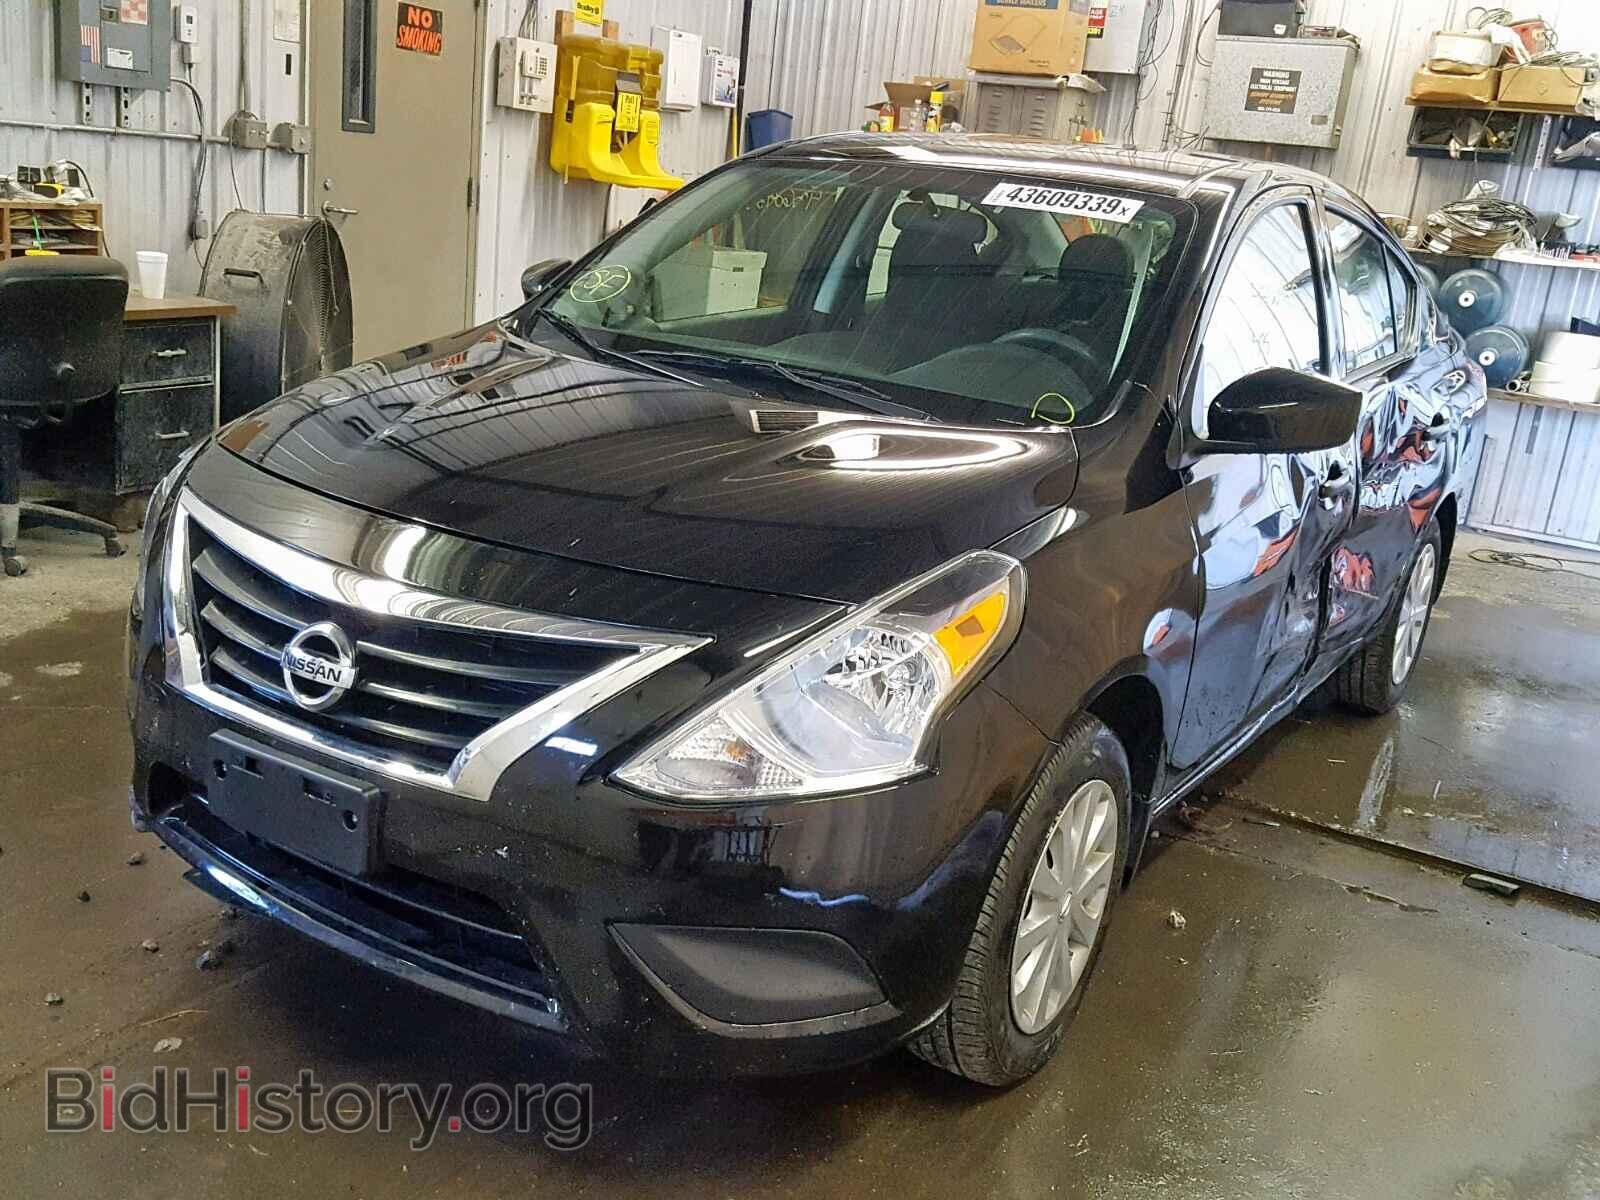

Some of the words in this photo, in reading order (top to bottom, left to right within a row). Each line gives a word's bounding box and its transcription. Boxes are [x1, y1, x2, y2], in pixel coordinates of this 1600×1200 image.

[407, 6, 433, 29] NO
[397, 25, 442, 54] SMOKING
[283, 650, 343, 683] NISSAN
